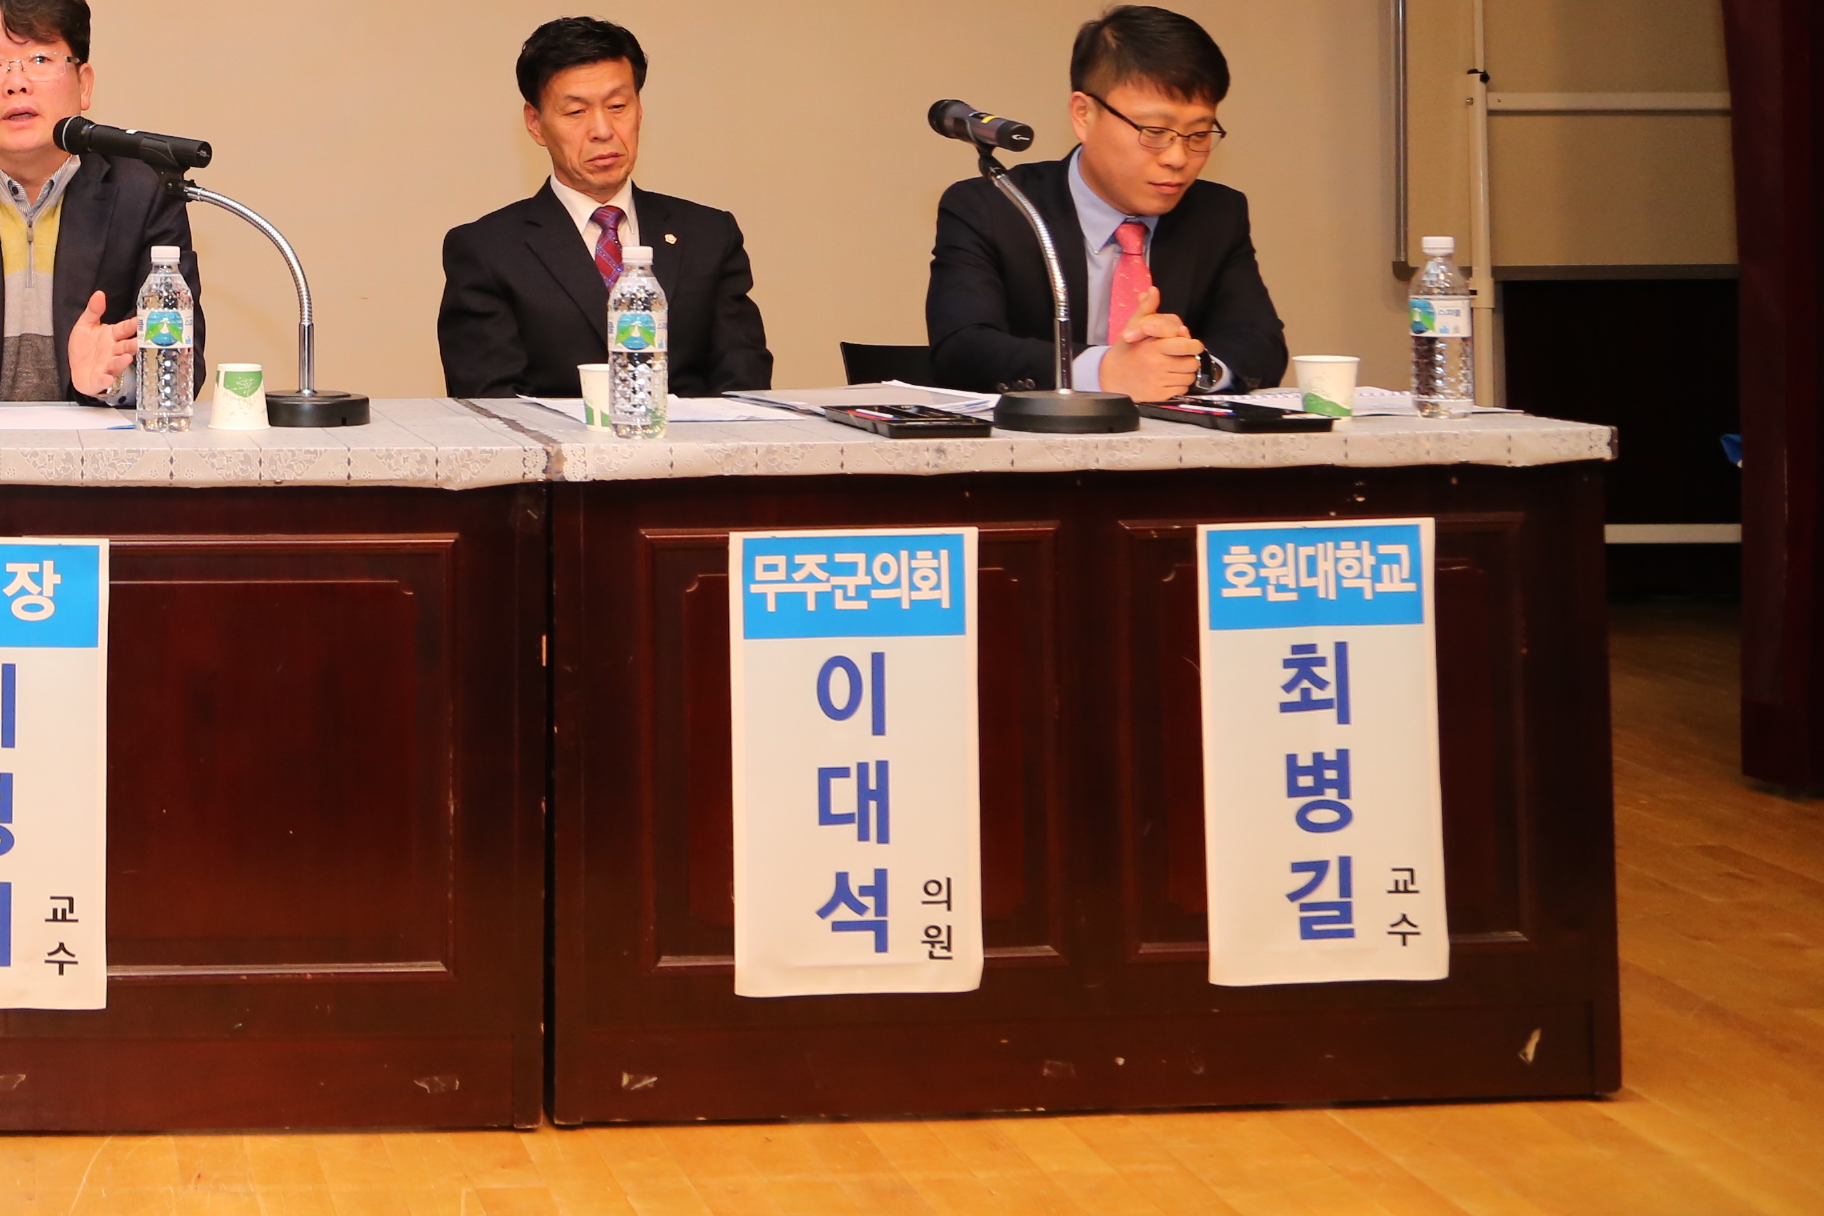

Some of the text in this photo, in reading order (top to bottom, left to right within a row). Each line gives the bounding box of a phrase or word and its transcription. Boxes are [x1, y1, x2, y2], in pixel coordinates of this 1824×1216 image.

[749, 549, 951, 613] 무주군의회
[1221, 540, 1417, 602] 호원대학교
[817, 652, 889, 952] 이대석
[1280, 641, 1354, 940] 최병길
[44, 896, 79, 976] 교수
[921, 877, 952, 960] 의원
[1387, 868, 1420, 947] 교수
